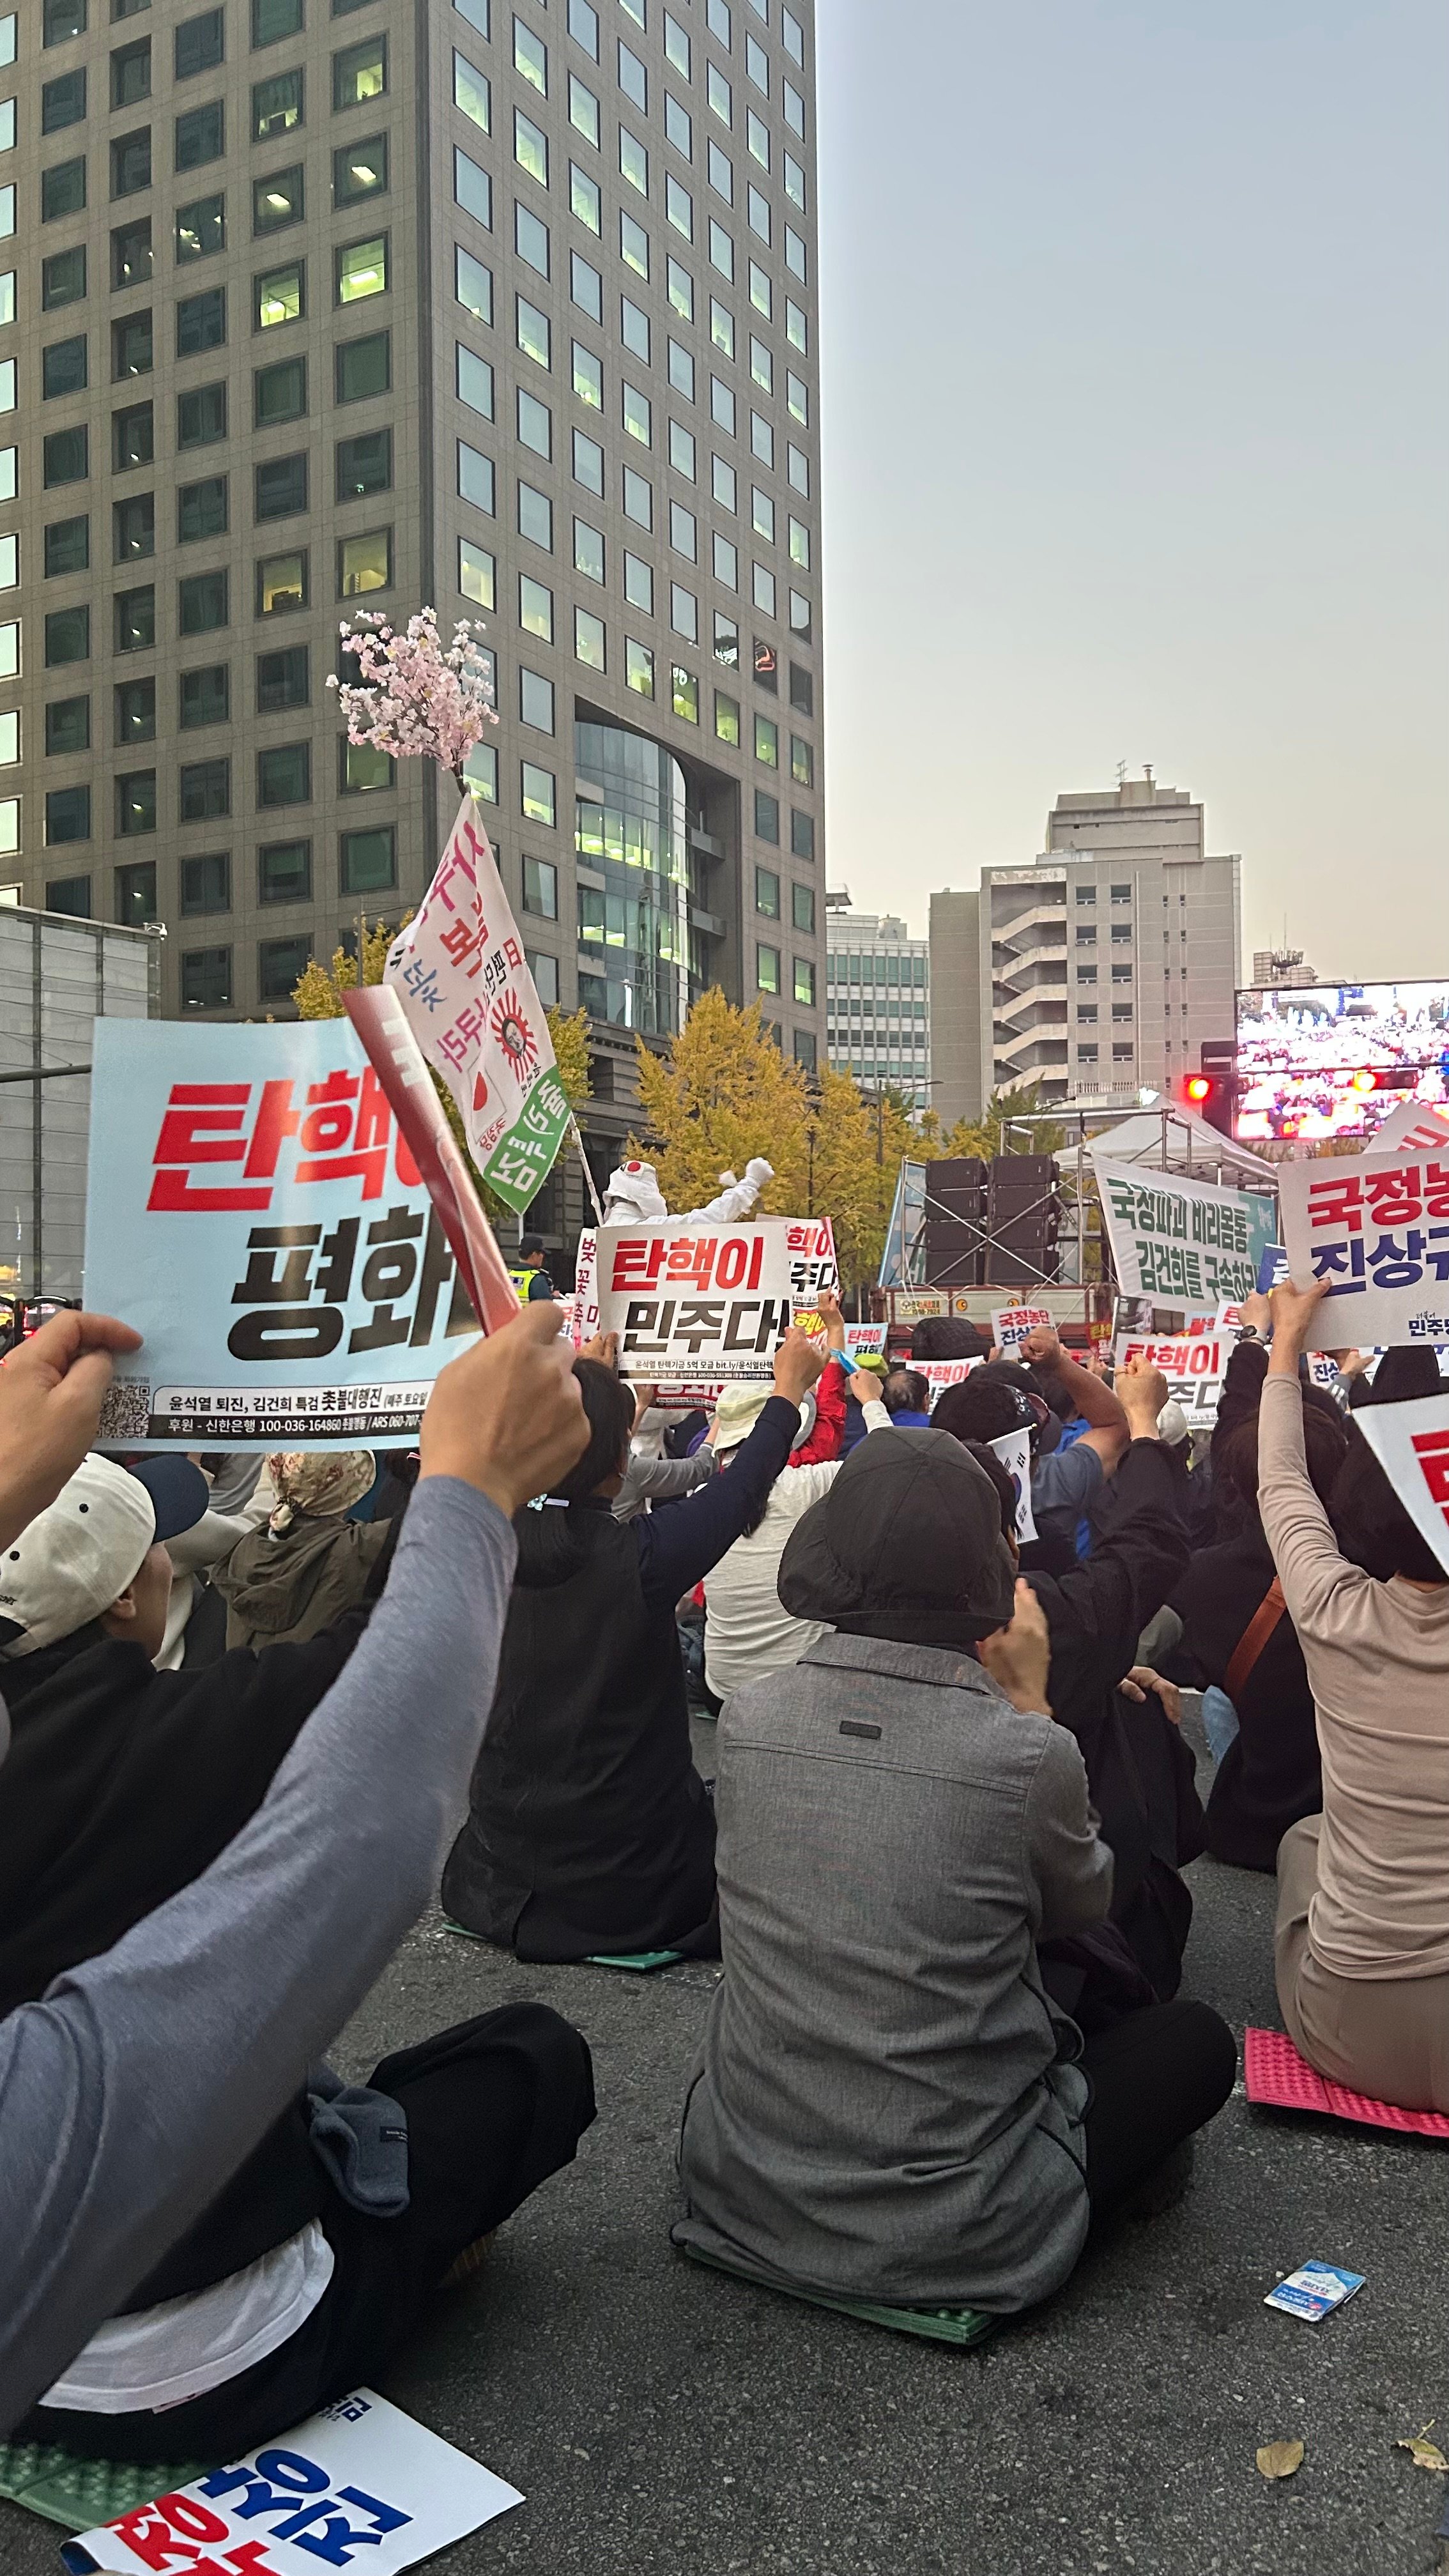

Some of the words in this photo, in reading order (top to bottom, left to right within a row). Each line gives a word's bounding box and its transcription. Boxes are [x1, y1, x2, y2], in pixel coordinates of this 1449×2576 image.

[146, 1067, 424, 1211] 탄핵
[1107, 1177, 1188, 1241] 국정파괴
[1188, 1198, 1248, 1254] 비리몸통
[786, 1225, 832, 1258] 핵이
[611, 1237, 764, 1292] 탄핵이
[1135, 1240, 1204, 1300] 김건희를
[622, 1299, 790, 1354] 민주다!
[998, 1310, 1050, 1327] 국정농단
[1408, 1319, 1449, 1337] 민주
[848, 1329, 881, 1344] 탄핵이
[657, 1360, 685, 1369] 탄핵기금
[687, 1360, 698, 1369] 5억
[700, 1360, 714, 1369] 모금
[169, 1396, 211, 1411] 윤석열
[216, 1397, 249, 1413] 퇴진,
[253, 1397, 292, 1411] 김건희
[295, 1397, 318, 1411] 특검
[321, 1387, 382, 1411] 촛불대행진
[167, 1418, 194, 1432] 후원
[205, 1419, 256, 1433] 신한은행
[259, 1418, 342, 1432] 100-036-164860
[371, 1415, 388, 1429] ARS
[388, 1414, 422, 1428] 060-707-
